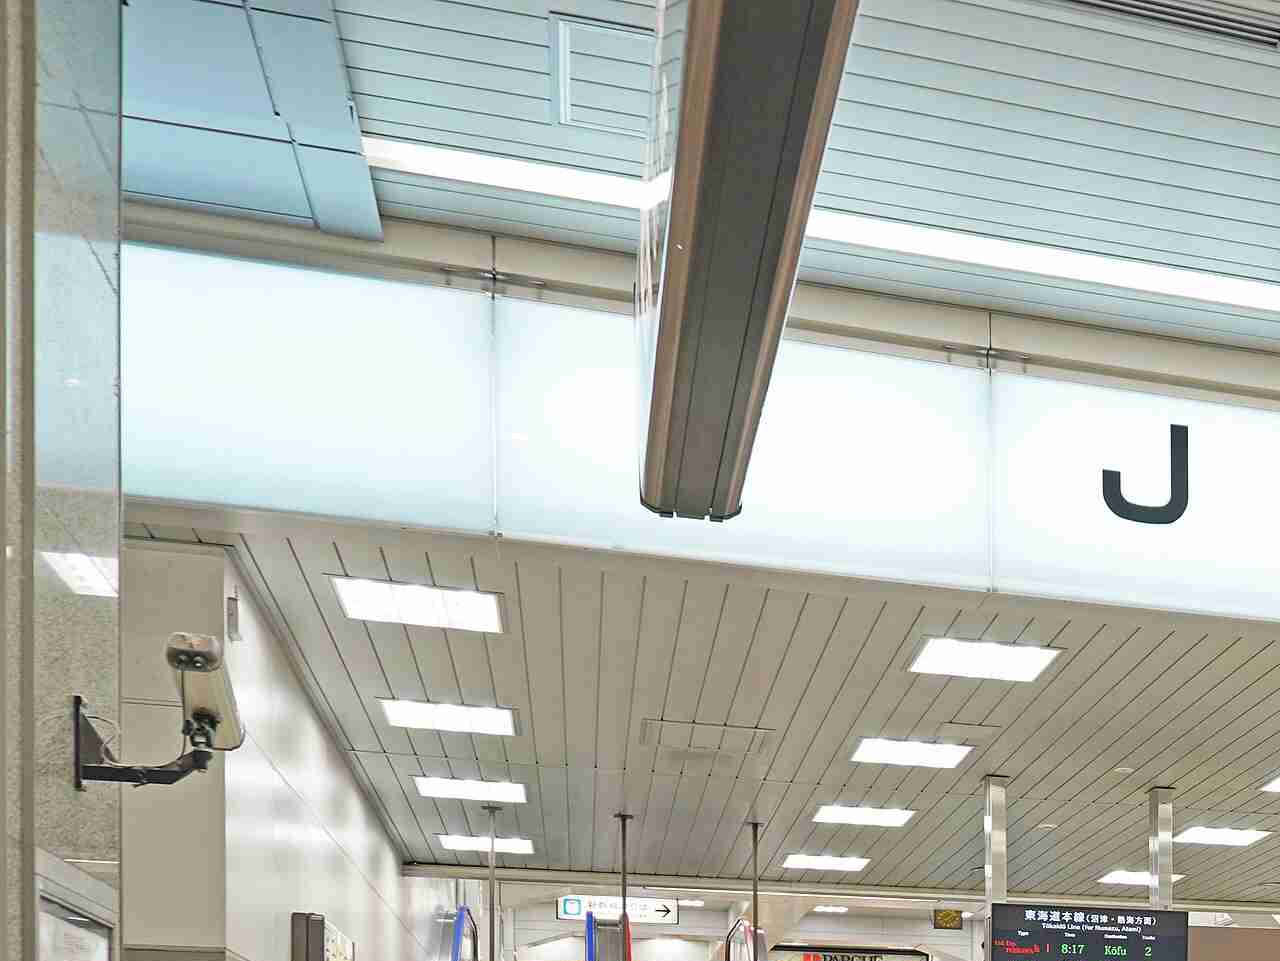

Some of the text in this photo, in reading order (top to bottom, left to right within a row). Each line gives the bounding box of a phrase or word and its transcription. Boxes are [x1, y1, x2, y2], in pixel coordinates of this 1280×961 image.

[1061, 944, 1085, 954] 8:17
[1104, 945, 1127, 956] Kōfu
[1144, 946, 1152, 956] 2
